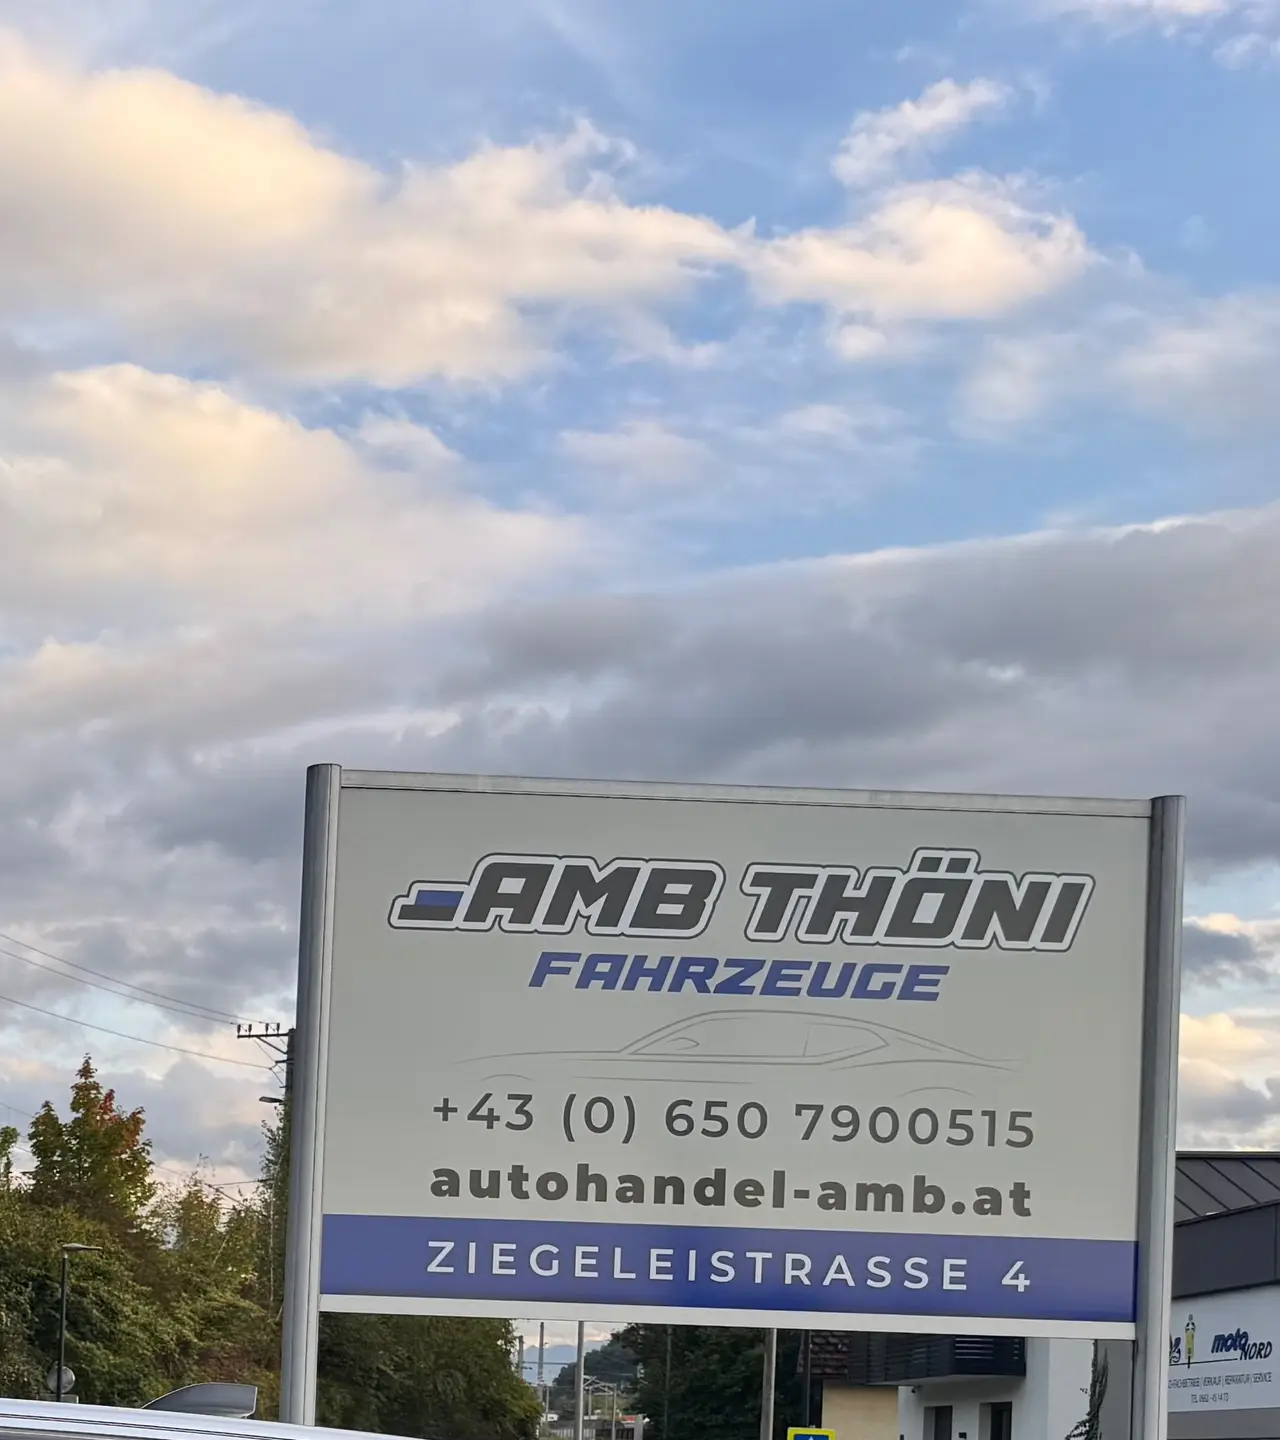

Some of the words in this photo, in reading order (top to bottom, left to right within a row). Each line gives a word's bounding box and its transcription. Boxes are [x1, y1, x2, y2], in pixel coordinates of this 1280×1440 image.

[458, 853, 724, 938] AMB
[742, 850, 1093, 950] THÖNI
[527, 950, 950, 1002] FAHRZEUGE
[433, 1093, 534, 1131] +43
[562, 1093, 636, 1144] (0)
[664, 1098, 769, 1140] 650
[794, 1103, 1035, 1148] 7900515
[429, 1162, 1032, 1217] autohandel-amb.at
[426, 1240, 968, 1291] ZIEGELEISTRASSE
[1000, 1260, 1031, 1293] 4
[1239, 1340, 1273, 1361] NORD
